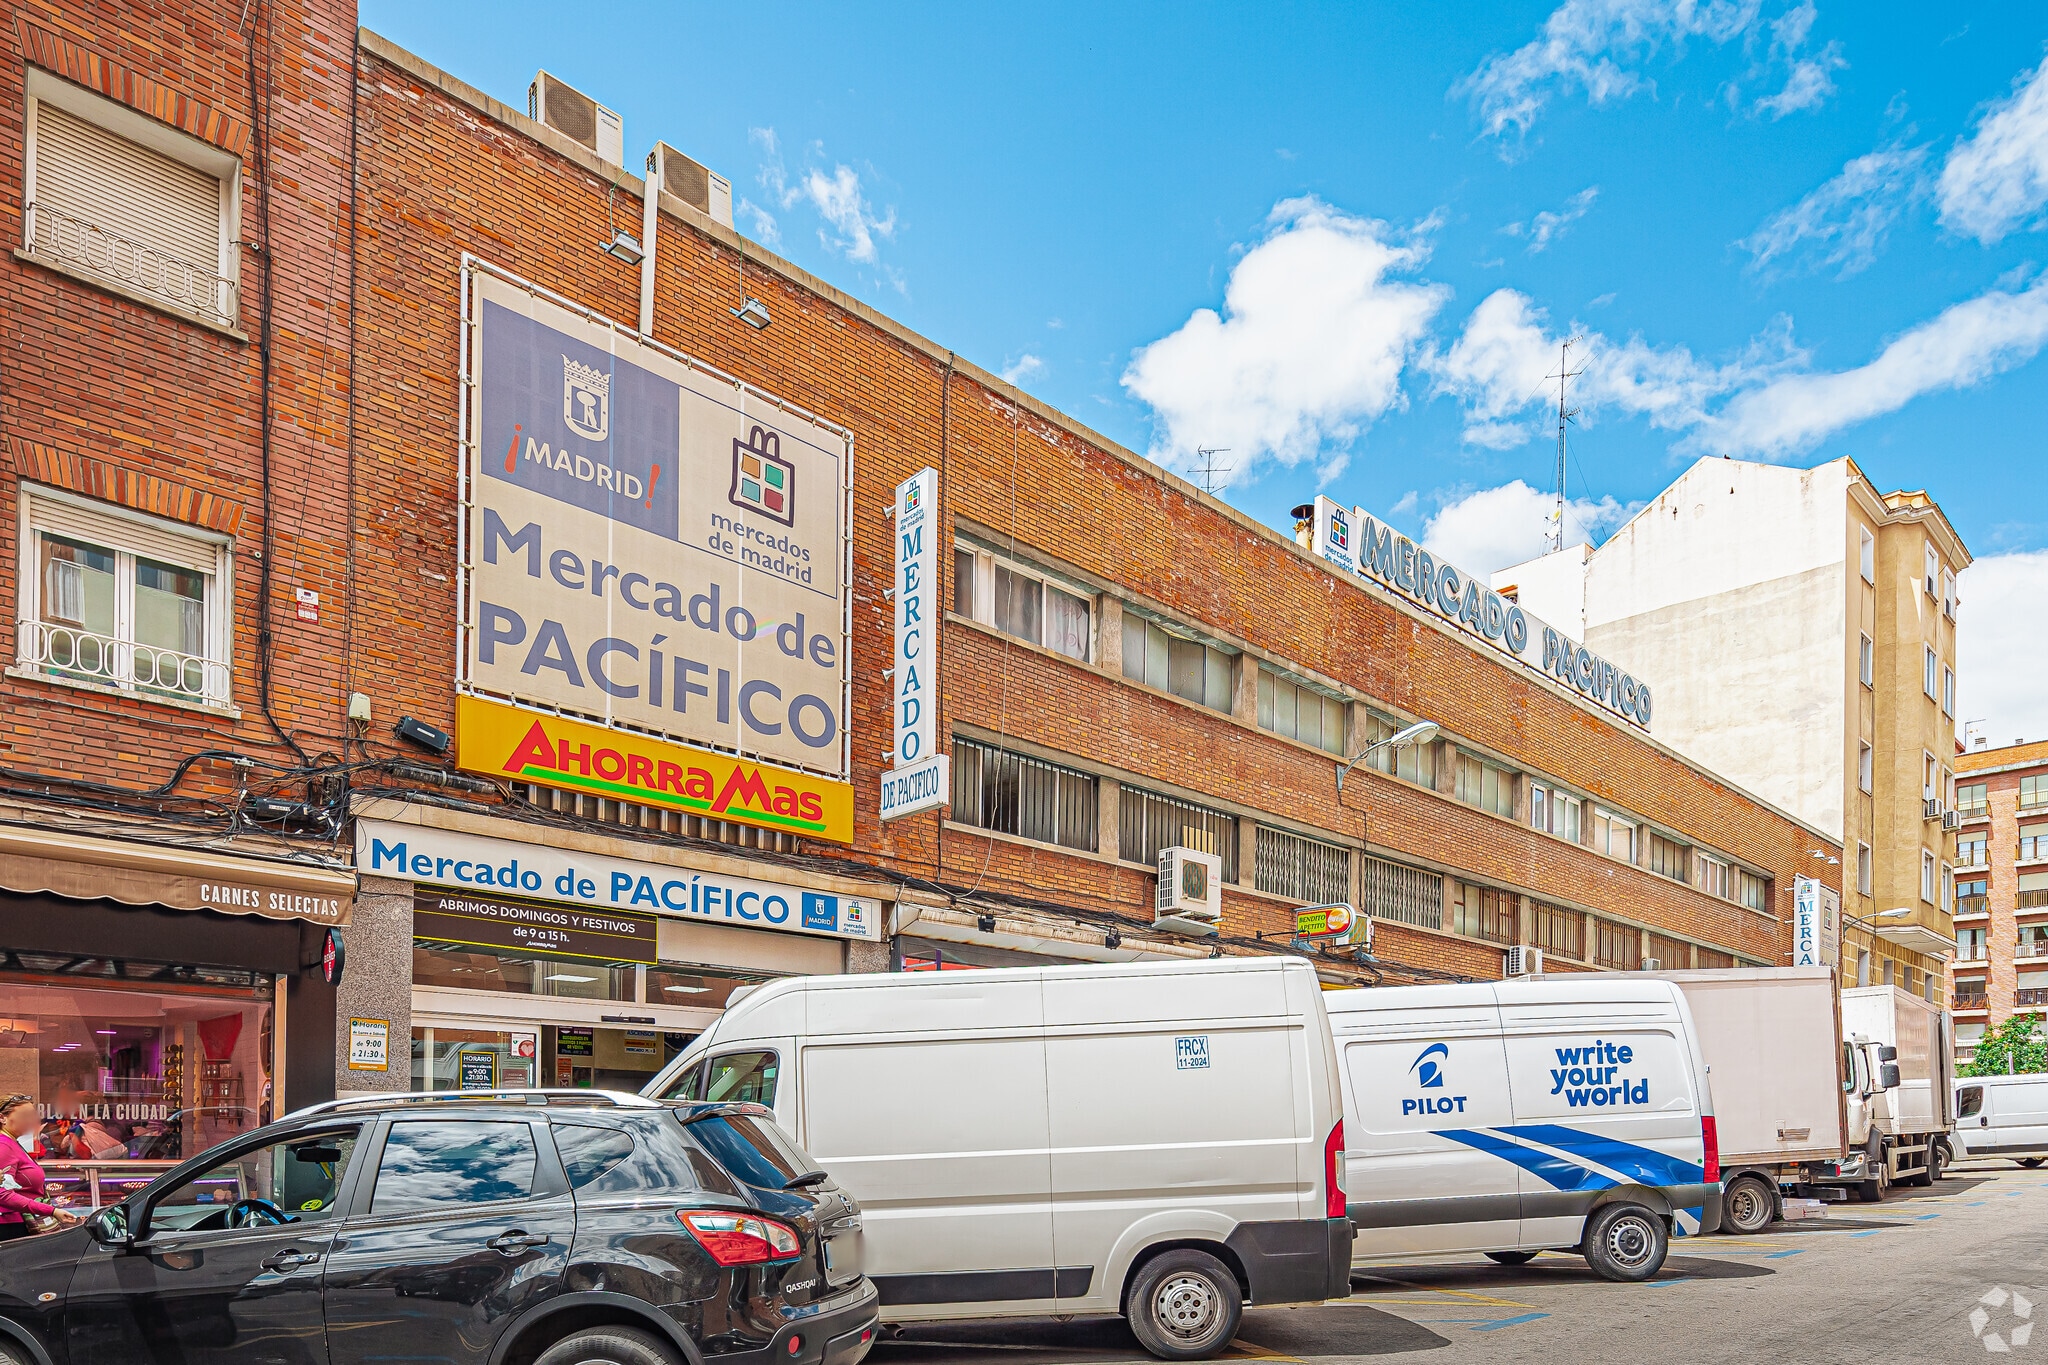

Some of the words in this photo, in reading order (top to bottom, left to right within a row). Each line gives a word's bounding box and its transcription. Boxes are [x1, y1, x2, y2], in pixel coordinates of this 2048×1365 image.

[710, 512, 811, 562] mercados
[708, 534, 735, 554] de
[741, 546, 812, 584] madrid
[1325, 544, 1353, 565] mercados
[482, 507, 756, 642] Mercado
[776, 612, 836, 668] de
[1358, 516, 1528, 654] MERCADO
[1542, 626, 1652, 725] PACIFICO
[901, 524, 923, 762] MERCADO
[478, 600, 837, 748] PACÍFICO
[882, 780, 895, 810] DE
[897, 764, 940, 807] PACIFICO
[372, 838, 542, 890] Mercado
[554, 868, 596, 898] de
[610, 872, 790, 924] PACÍFICO
[200, 884, 260, 908] CARNES
[269, 892, 338, 916] SELECTAS
[438, 898, 498, 916] ABRIMOS
[500, 906, 568, 925] DOMINGOS
[571, 916, 580, 926] Y
[582, 918, 635, 933] FESTIVOS
[1298, 914, 1326, 924] BENDITO
[1300, 922, 1326, 930] APETITO
[512, 926, 528, 938] de
[530, 928, 536, 938] 9
[538, 931, 546, 940] a
[548, 930, 558, 941] 15
[560, 932, 570, 942] h.
[360, 1021, 387, 1030] Horario
[358, 1050, 378, 1058] 21:30
[366, 1040, 382, 1048] 9:00
[1178, 1038, 1206, 1056] FRCX
[1554, 1040, 1633, 1066] write
[1179, 1057, 1207, 1067] 11-2024
[1550, 1066, 1618, 1095] your
[1565, 1078, 1649, 1107] world
[94, 1104, 110, 1120] LA
[116, 1104, 168, 1120] CIUDAD
[1402, 1096, 1468, 1116] PILOT
[786, 1278, 816, 1294] QASHQAI
